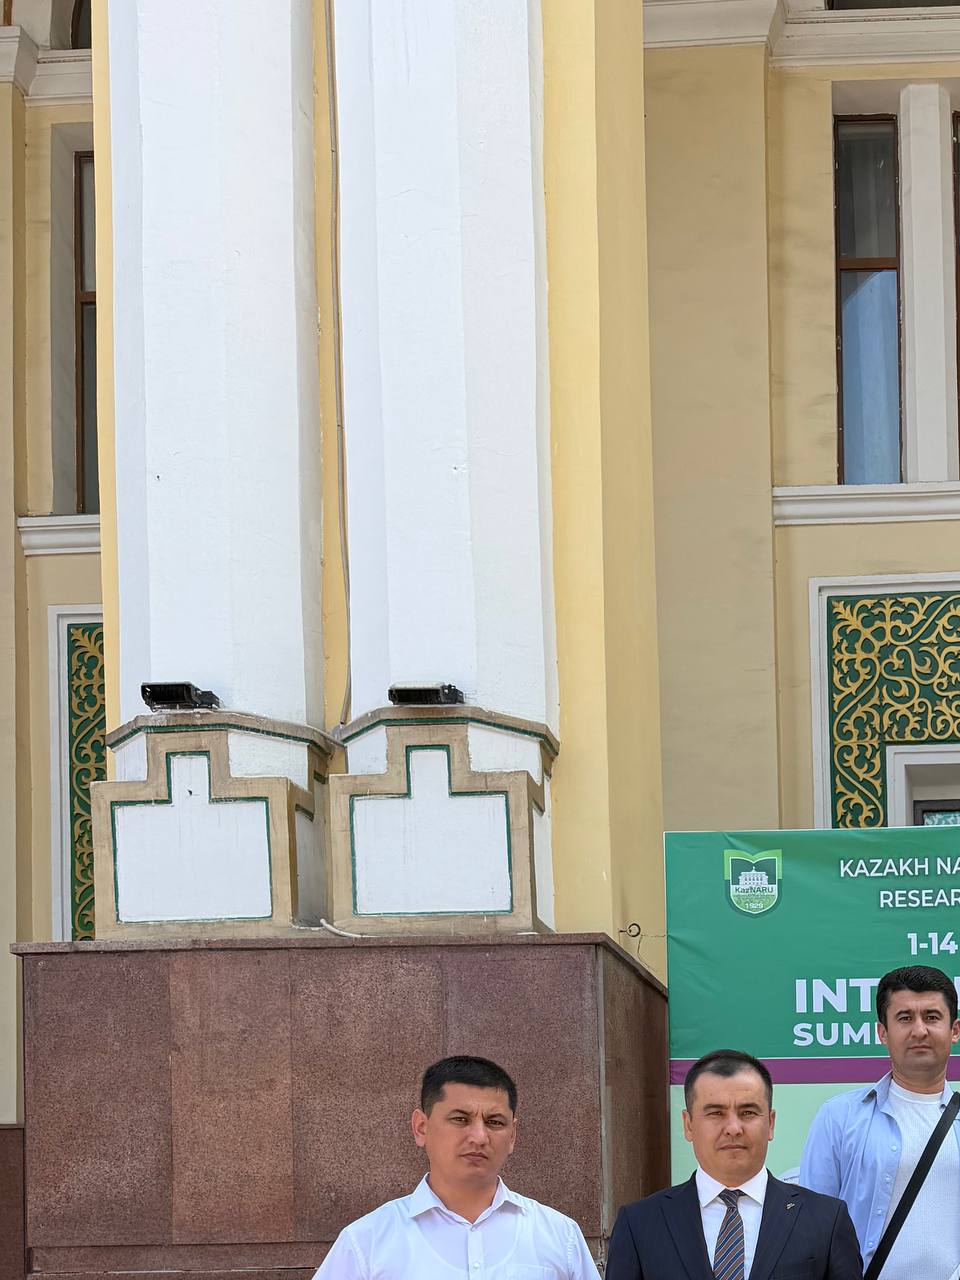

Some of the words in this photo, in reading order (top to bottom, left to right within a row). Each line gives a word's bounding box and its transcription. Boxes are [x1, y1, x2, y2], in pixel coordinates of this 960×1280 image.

[839, 857, 930, 878] KAZAKH
[907, 932, 959, 955] 1-14
[793, 1022, 882, 1047] SUM
